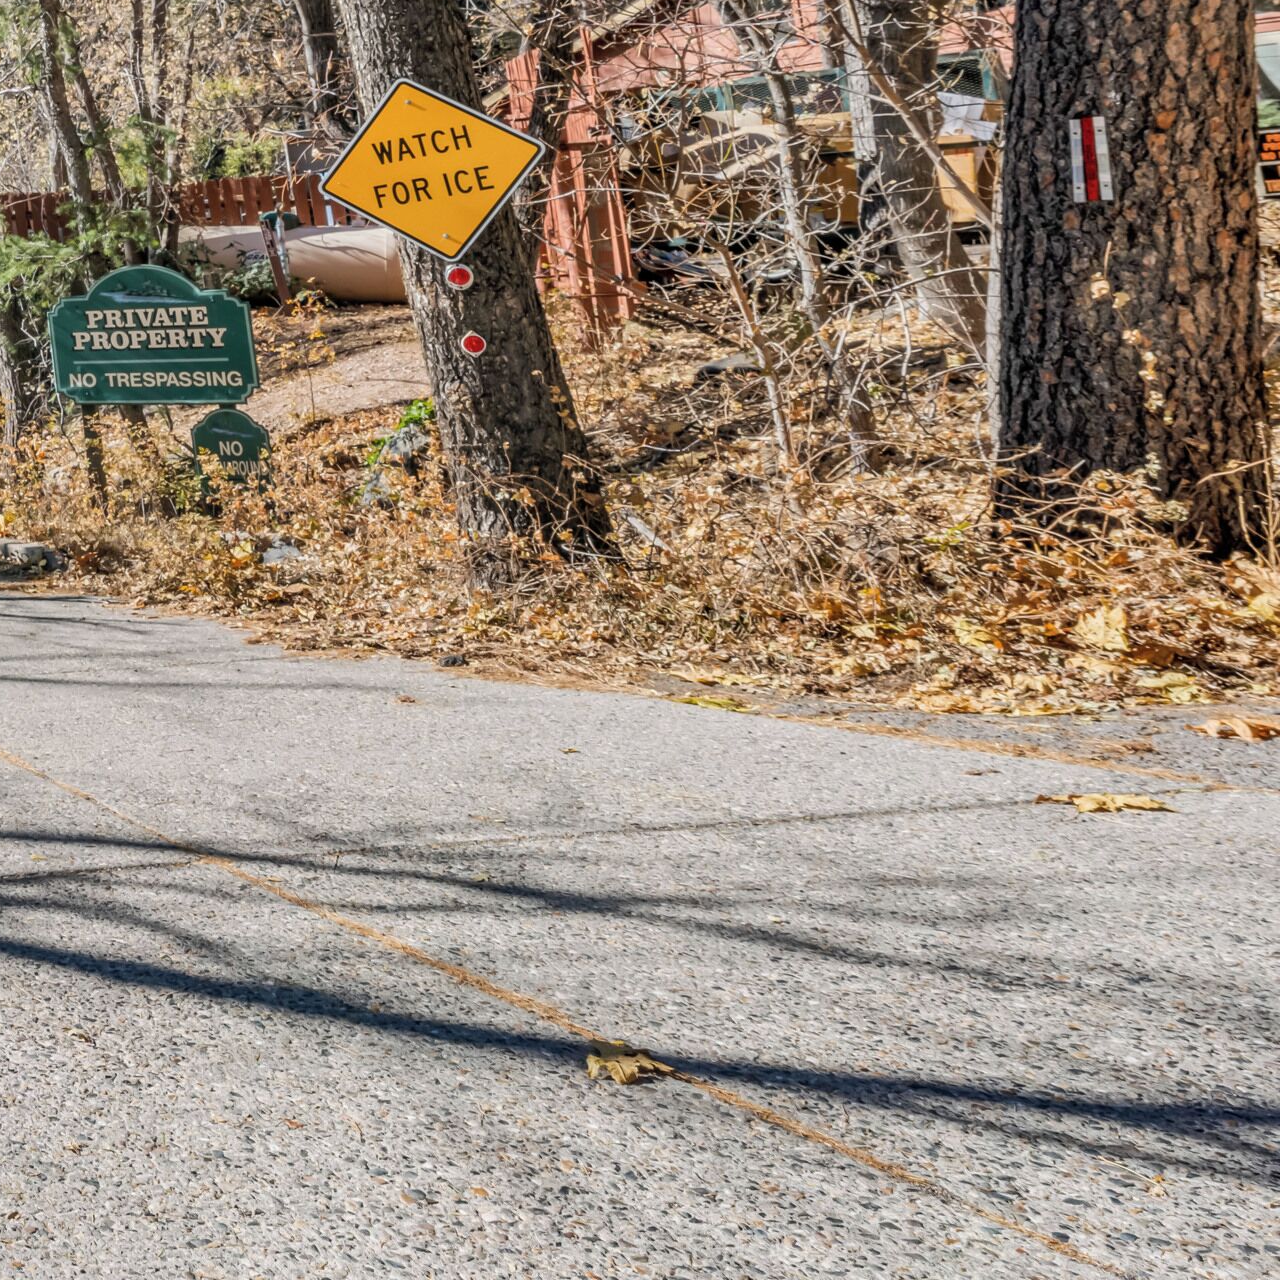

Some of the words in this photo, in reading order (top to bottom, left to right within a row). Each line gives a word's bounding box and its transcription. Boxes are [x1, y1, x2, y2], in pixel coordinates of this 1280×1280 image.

[372, 125, 472, 165] WATCH
[374, 177, 433, 208] FOR
[443, 166, 495, 197] ICE
[85, 306, 209, 329] PRIVATE
[72, 327, 227, 351] PROPERTY
[69, 373, 97, 388] NO
[104, 371, 243, 387] TRESPASSING
[218, 440, 243, 456] NO
